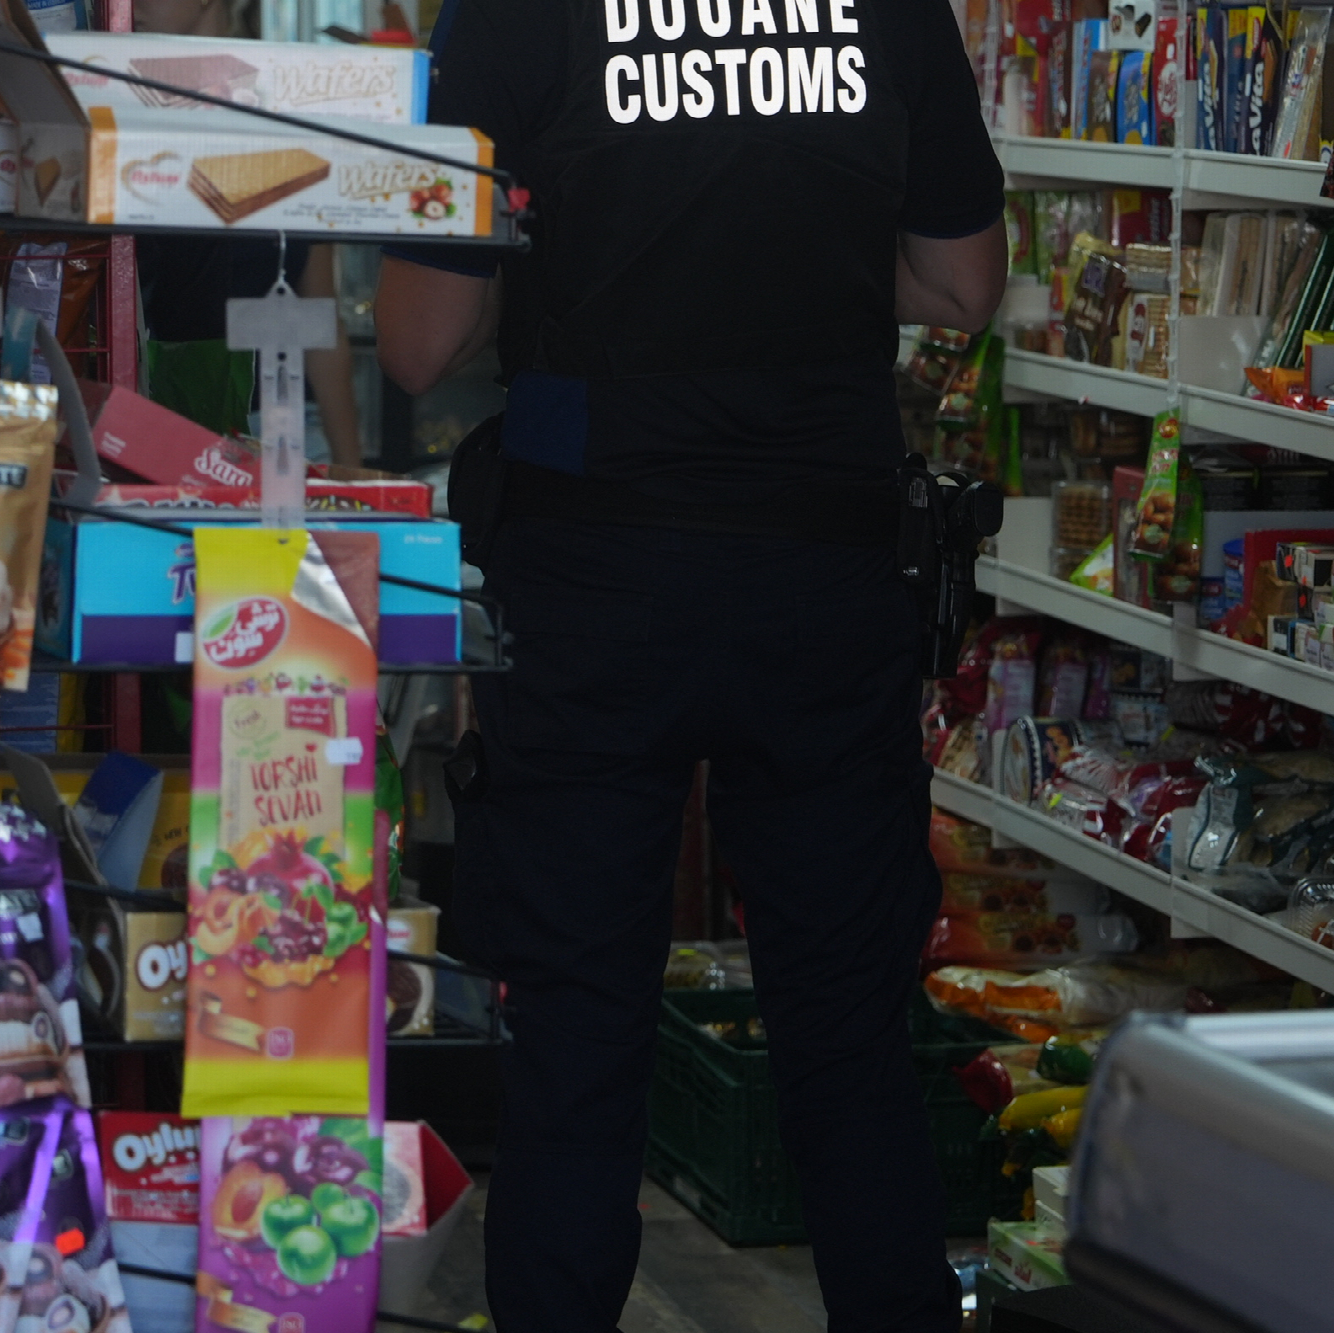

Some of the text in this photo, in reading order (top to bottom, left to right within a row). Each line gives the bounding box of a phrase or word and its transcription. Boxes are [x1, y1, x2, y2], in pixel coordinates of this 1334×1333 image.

[272, 61, 395, 104] Wafers
[604, 45, 867, 124] CUSTOMS
[337, 162, 439, 198] Wafers
